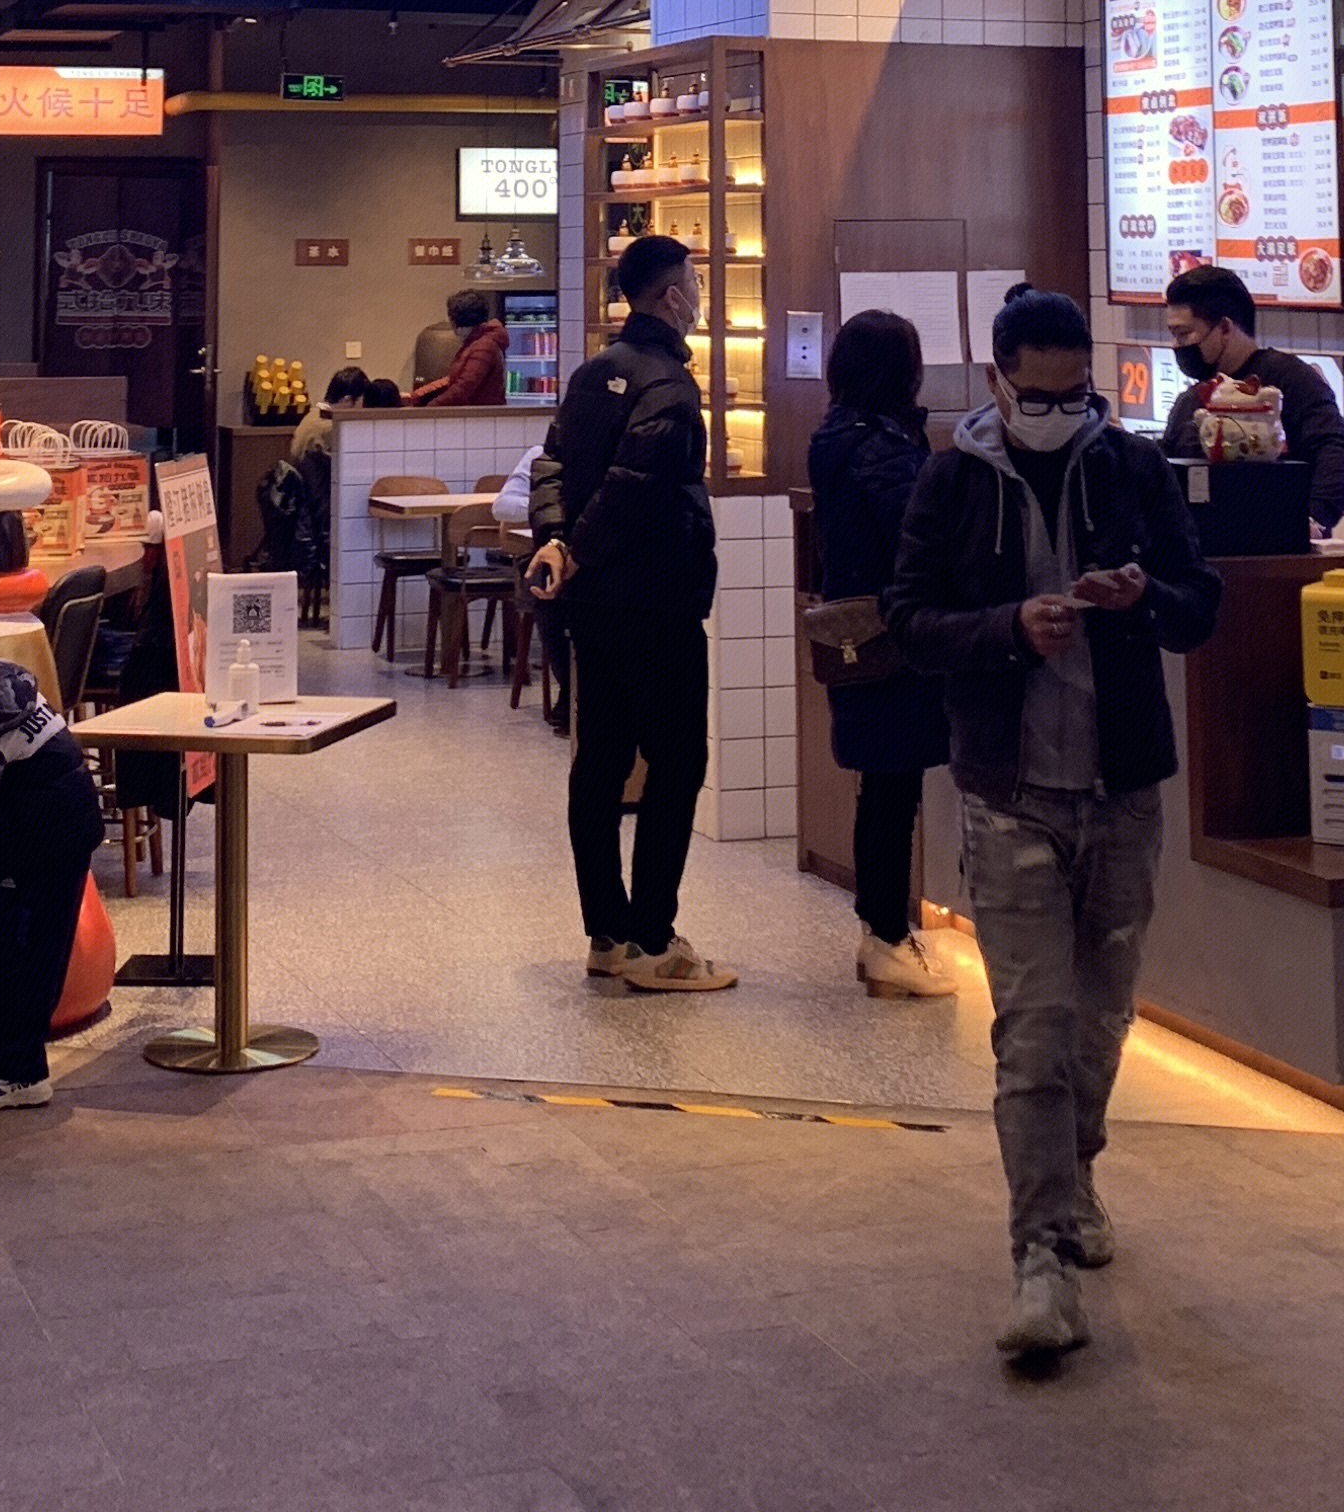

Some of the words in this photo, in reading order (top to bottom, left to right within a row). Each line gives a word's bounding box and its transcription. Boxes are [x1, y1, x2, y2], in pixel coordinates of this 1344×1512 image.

[481, 160, 557, 173] TONGL
[308, 245, 339, 257] 茶水
[1121, 361, 1149, 404] 29
[19, 701, 55, 744] JUST
